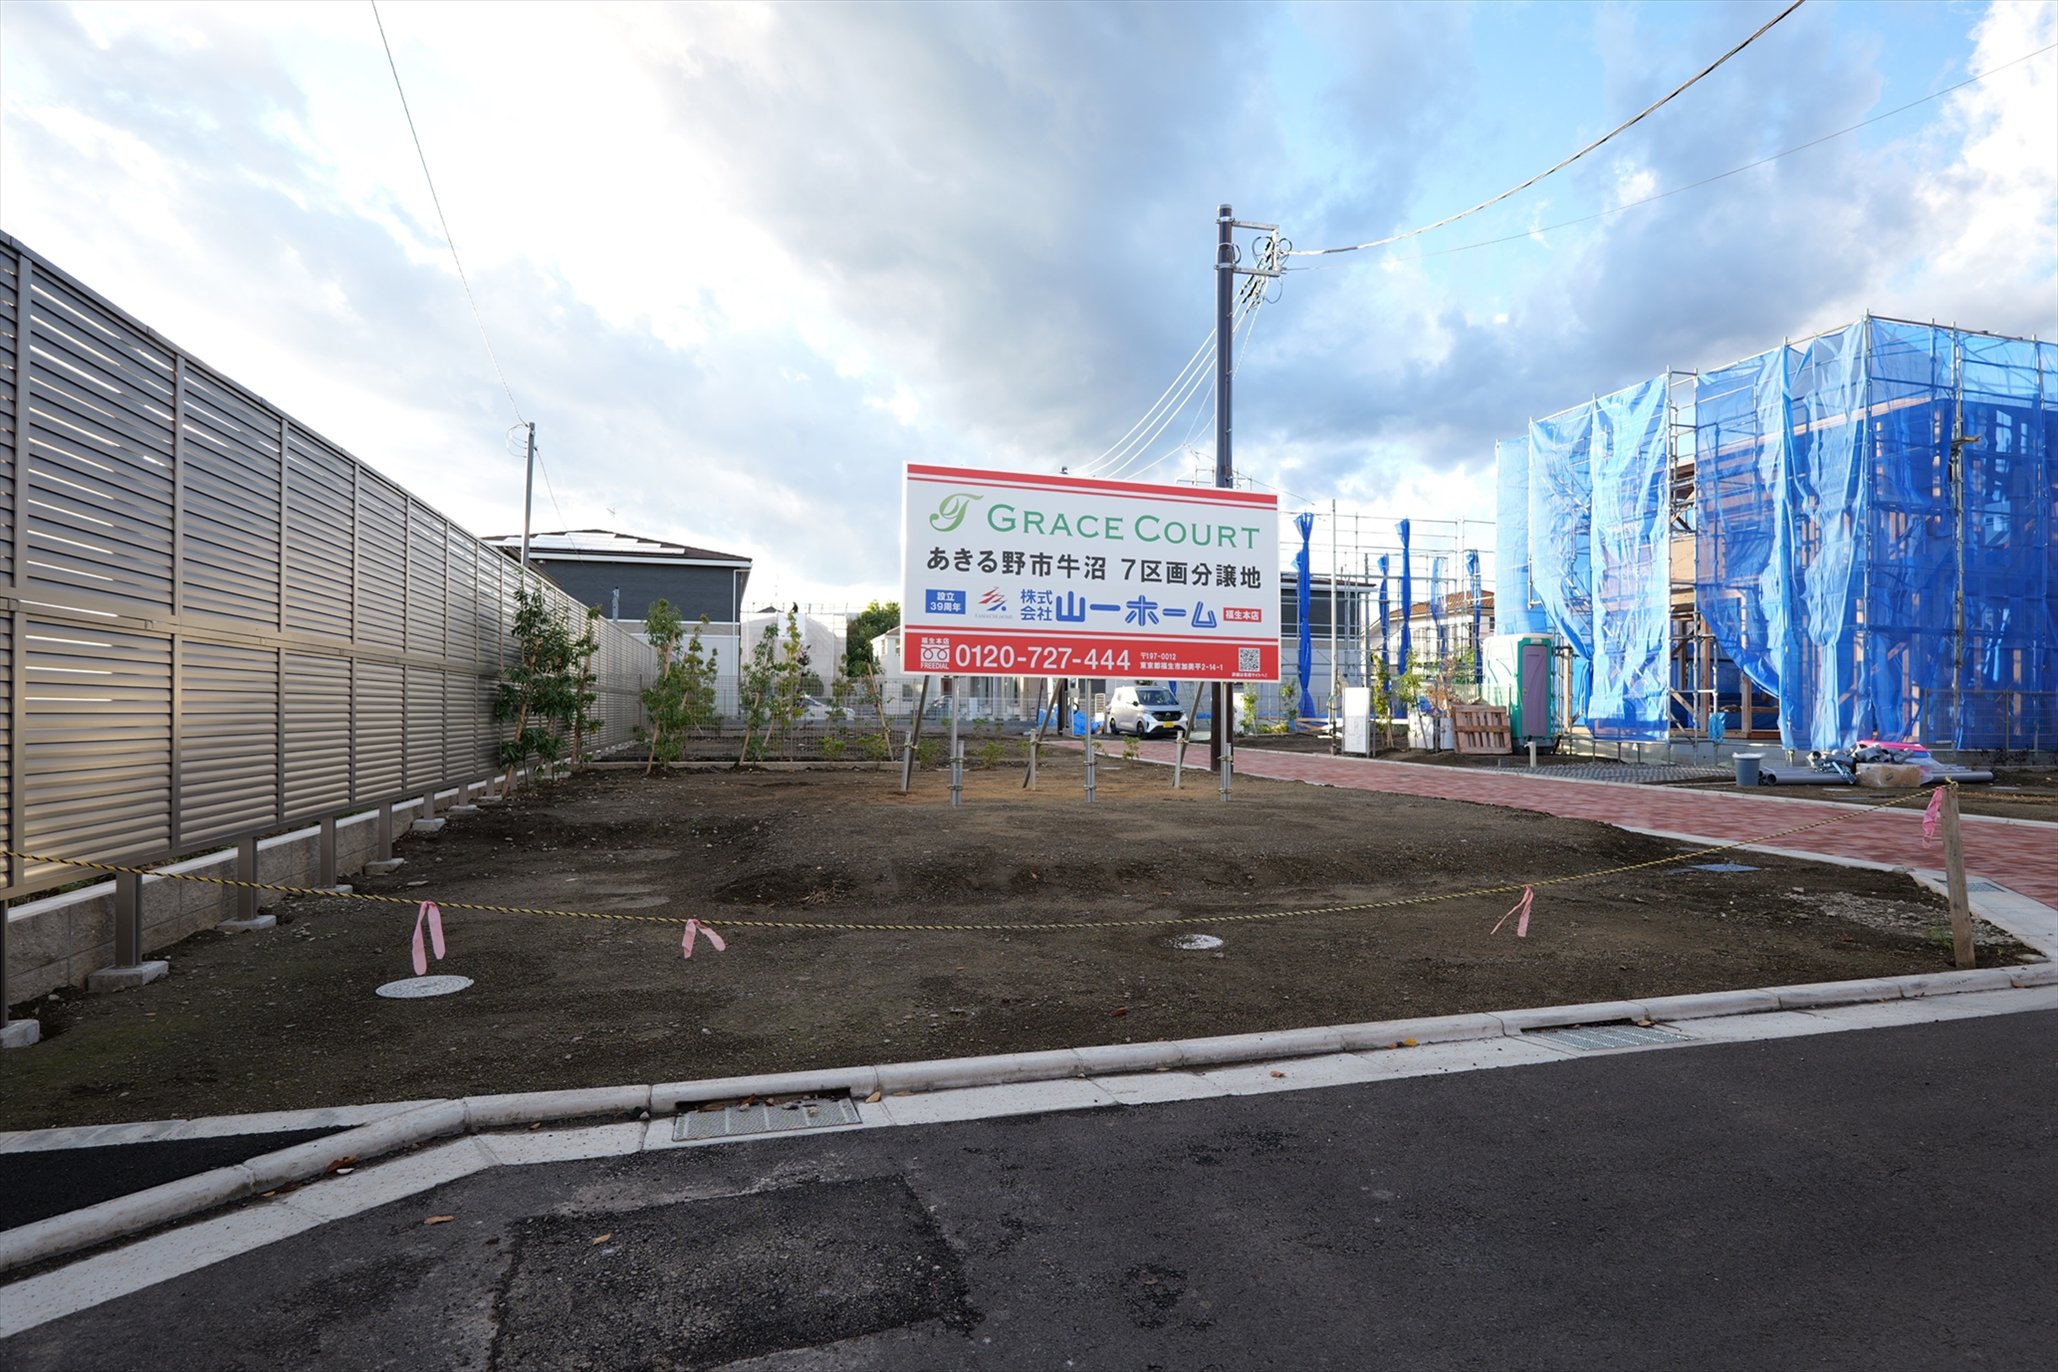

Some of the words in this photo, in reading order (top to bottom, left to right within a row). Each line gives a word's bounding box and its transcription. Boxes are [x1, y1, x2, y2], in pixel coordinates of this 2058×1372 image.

[987, 504, 1124, 540] GRACE
[1134, 515, 1260, 549] COURT
[927, 547, 1106, 580] あきる野市牛沼
[1121, 558, 1261, 589] 7区画分譲地
[937, 592, 955, 601] 設立
[1020, 589, 1053, 605] 株式
[930, 602, 961, 612] 39周年
[1020, 605, 1053, 621] 会社
[1056, 591, 1217, 628] 山一ホーム
[1224, 610, 1260, 621] 福生本店
[955, 644, 1131, 671] 0120-727-444
[920, 662, 950, 670] FREEDIAL
